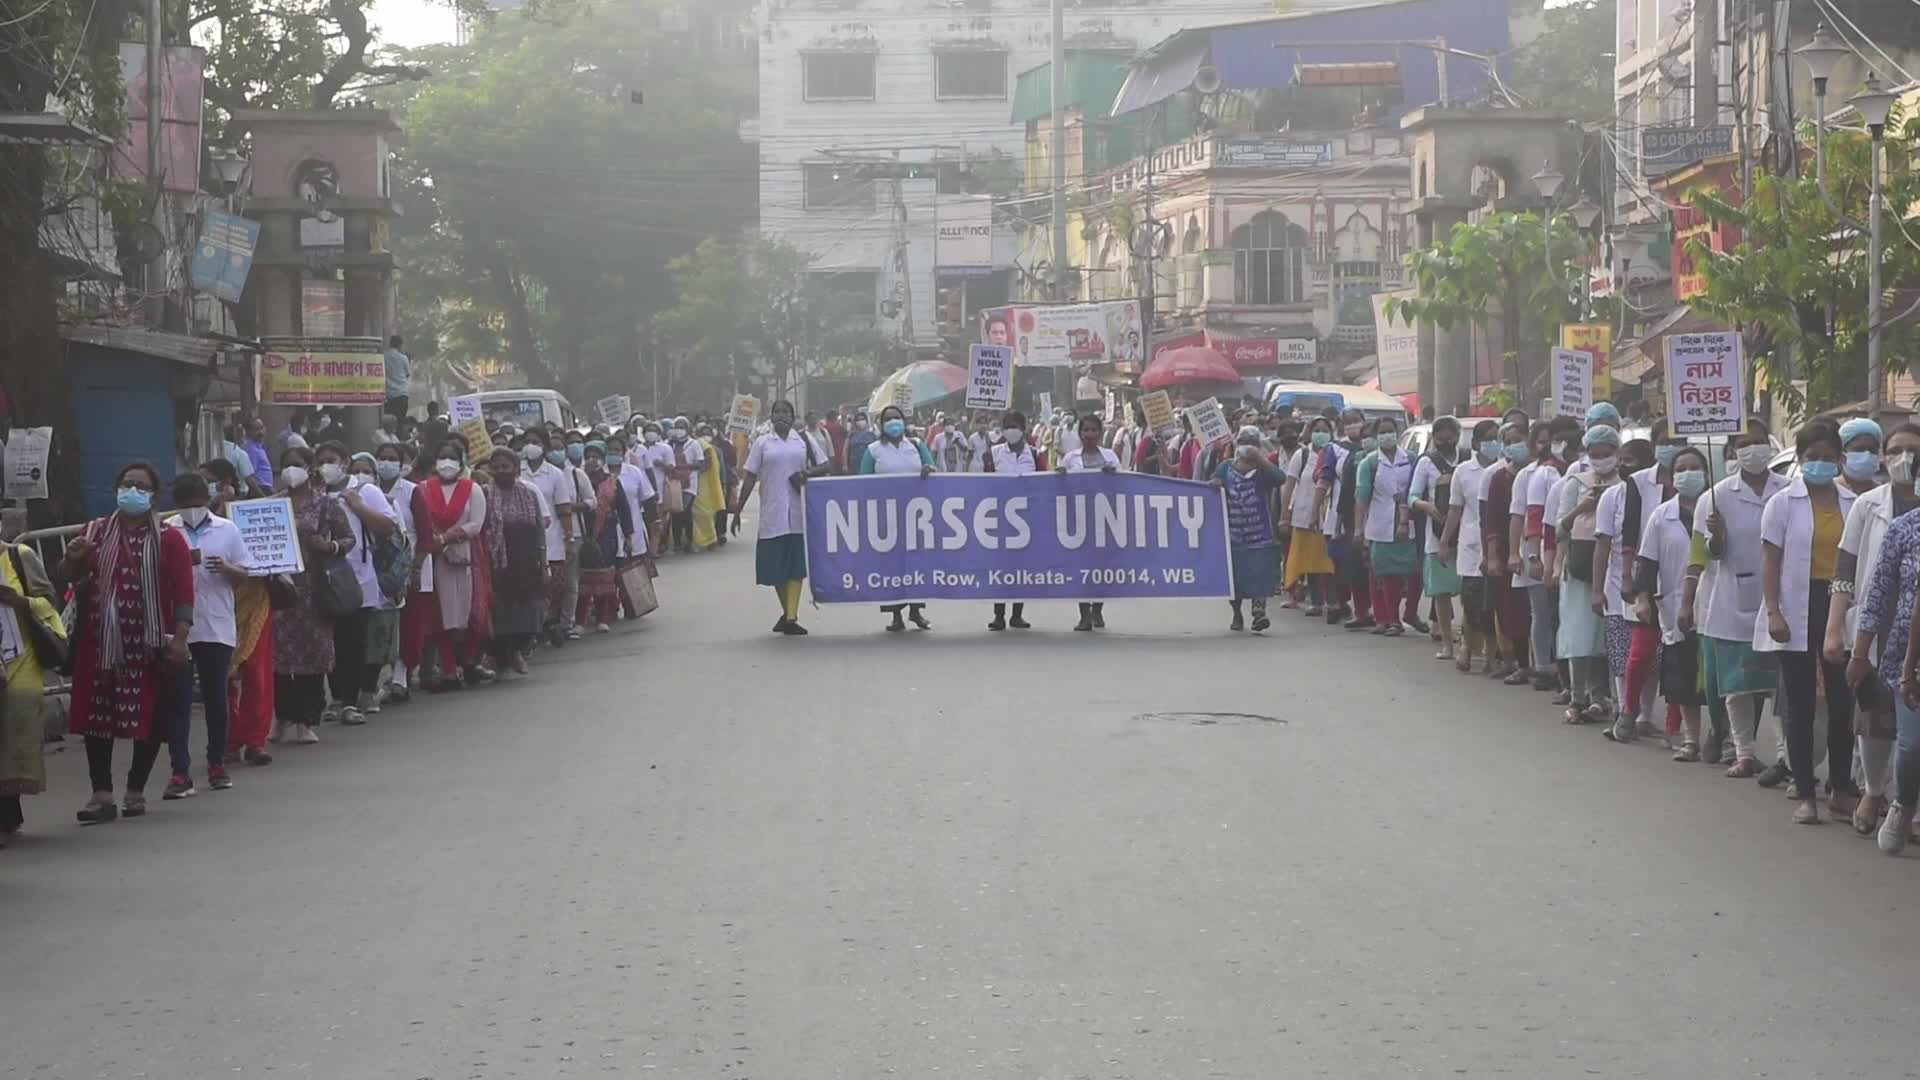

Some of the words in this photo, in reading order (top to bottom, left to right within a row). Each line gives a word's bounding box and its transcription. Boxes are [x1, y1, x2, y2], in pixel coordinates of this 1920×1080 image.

[1288, 343, 1305, 351] MD
[981, 350, 1001, 358] WILL
[1279, 351, 1313, 360] ISRAIL
[977, 359, 1004, 368] WORK
[1684, 354, 1726, 379] নার্স
[980, 369, 999, 377] FOR
[974, 378, 1004, 387] EQUAL
[979, 388, 997, 396] PAY
[1679, 382, 1733, 405] নিগ্রহ
[825, 496, 1031, 553] NURSES
[1055, 492, 1205, 549] UNITY
[842, 573, 860, 591] 9,
[867, 569, 925, 588] Creek
[932, 569, 981, 588] Row,
[988, 568, 1073, 586] Kolkata-
[1080, 568, 1156, 586] 700014,
[1163, 568, 1195, 584] WB
